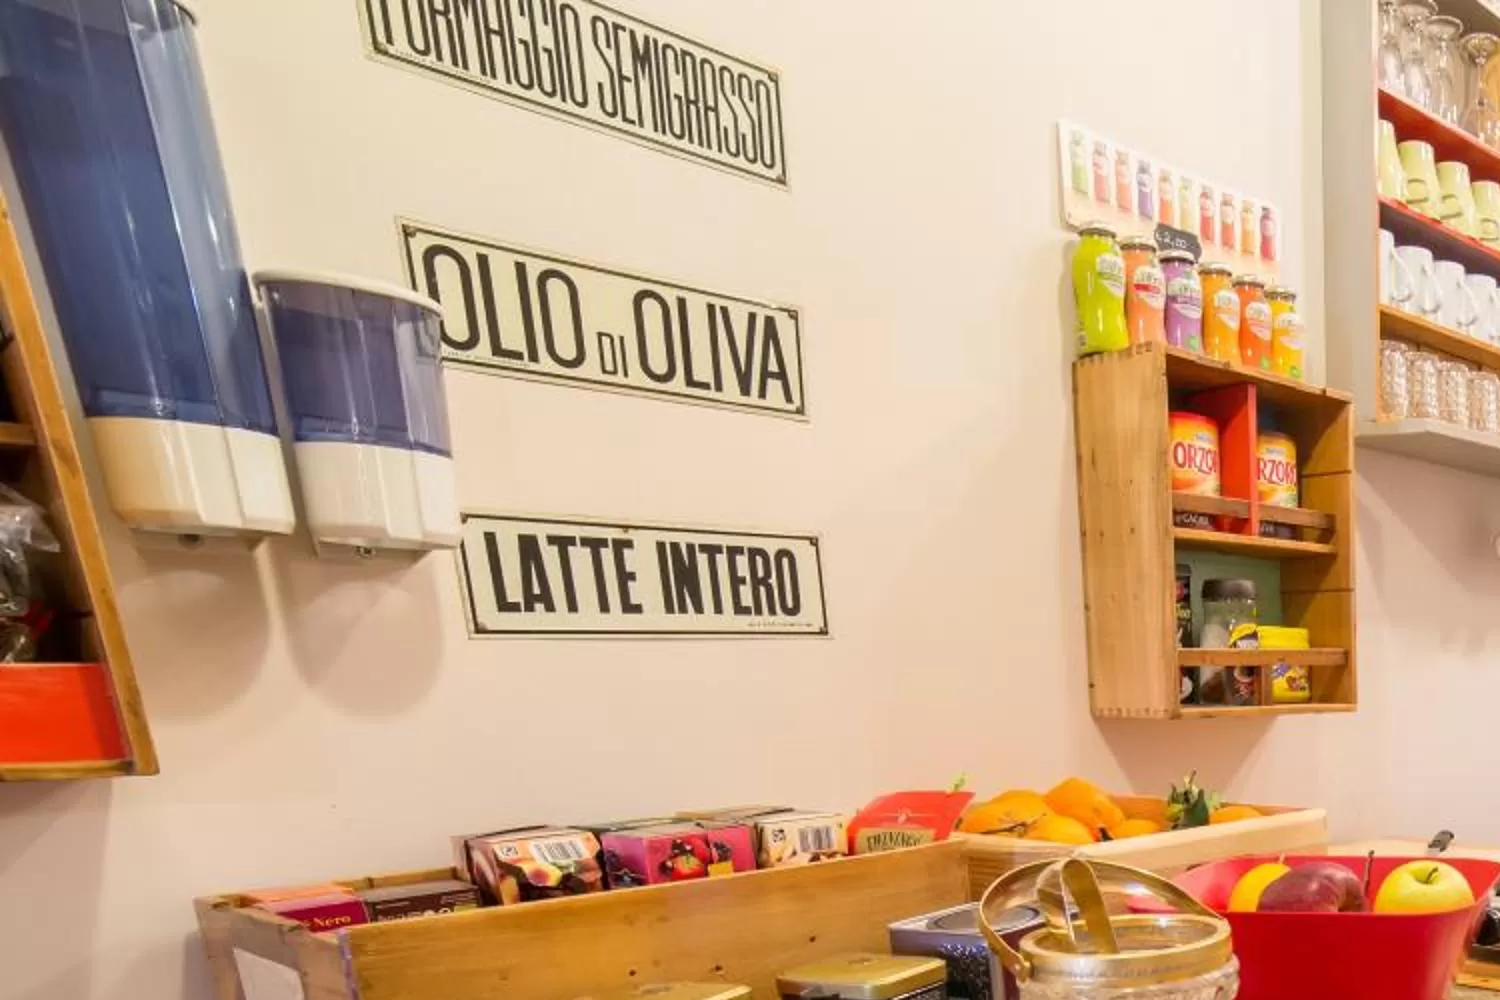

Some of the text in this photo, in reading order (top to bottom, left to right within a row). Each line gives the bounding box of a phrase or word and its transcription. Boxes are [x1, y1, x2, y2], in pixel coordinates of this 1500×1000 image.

[589, 15, 776, 170] SEMIGRASSO
[421, 244, 794, 405] OLIO DI OLIVA
[483, 530, 802, 617] LATTE INTERO
